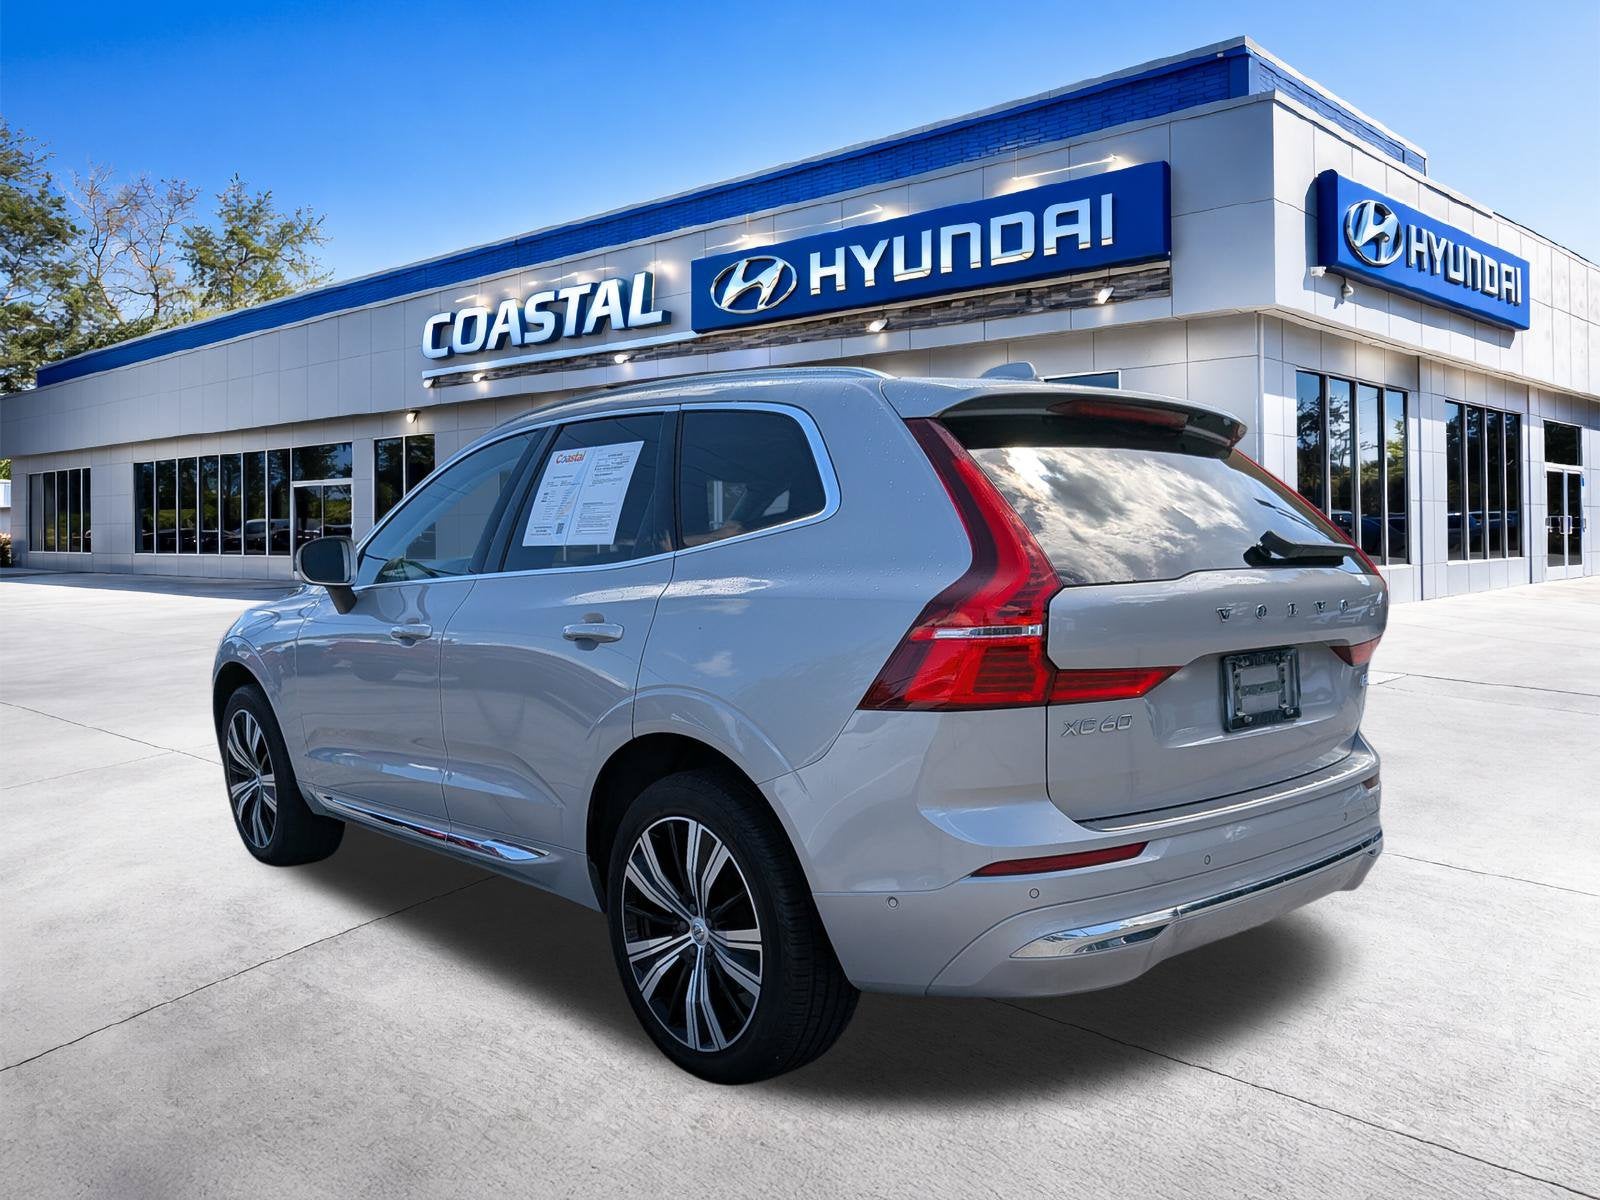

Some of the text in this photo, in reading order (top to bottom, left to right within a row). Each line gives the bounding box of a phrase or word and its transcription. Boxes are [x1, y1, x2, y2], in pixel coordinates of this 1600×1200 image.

[809, 193, 1113, 295] HYUNDAI
[1407, 224, 1522, 305] HYUNDAI
[422, 271, 667, 360] COASTAL
[555, 451, 587, 464] Coastal
[1216, 599, 1349, 623] VOLVO
